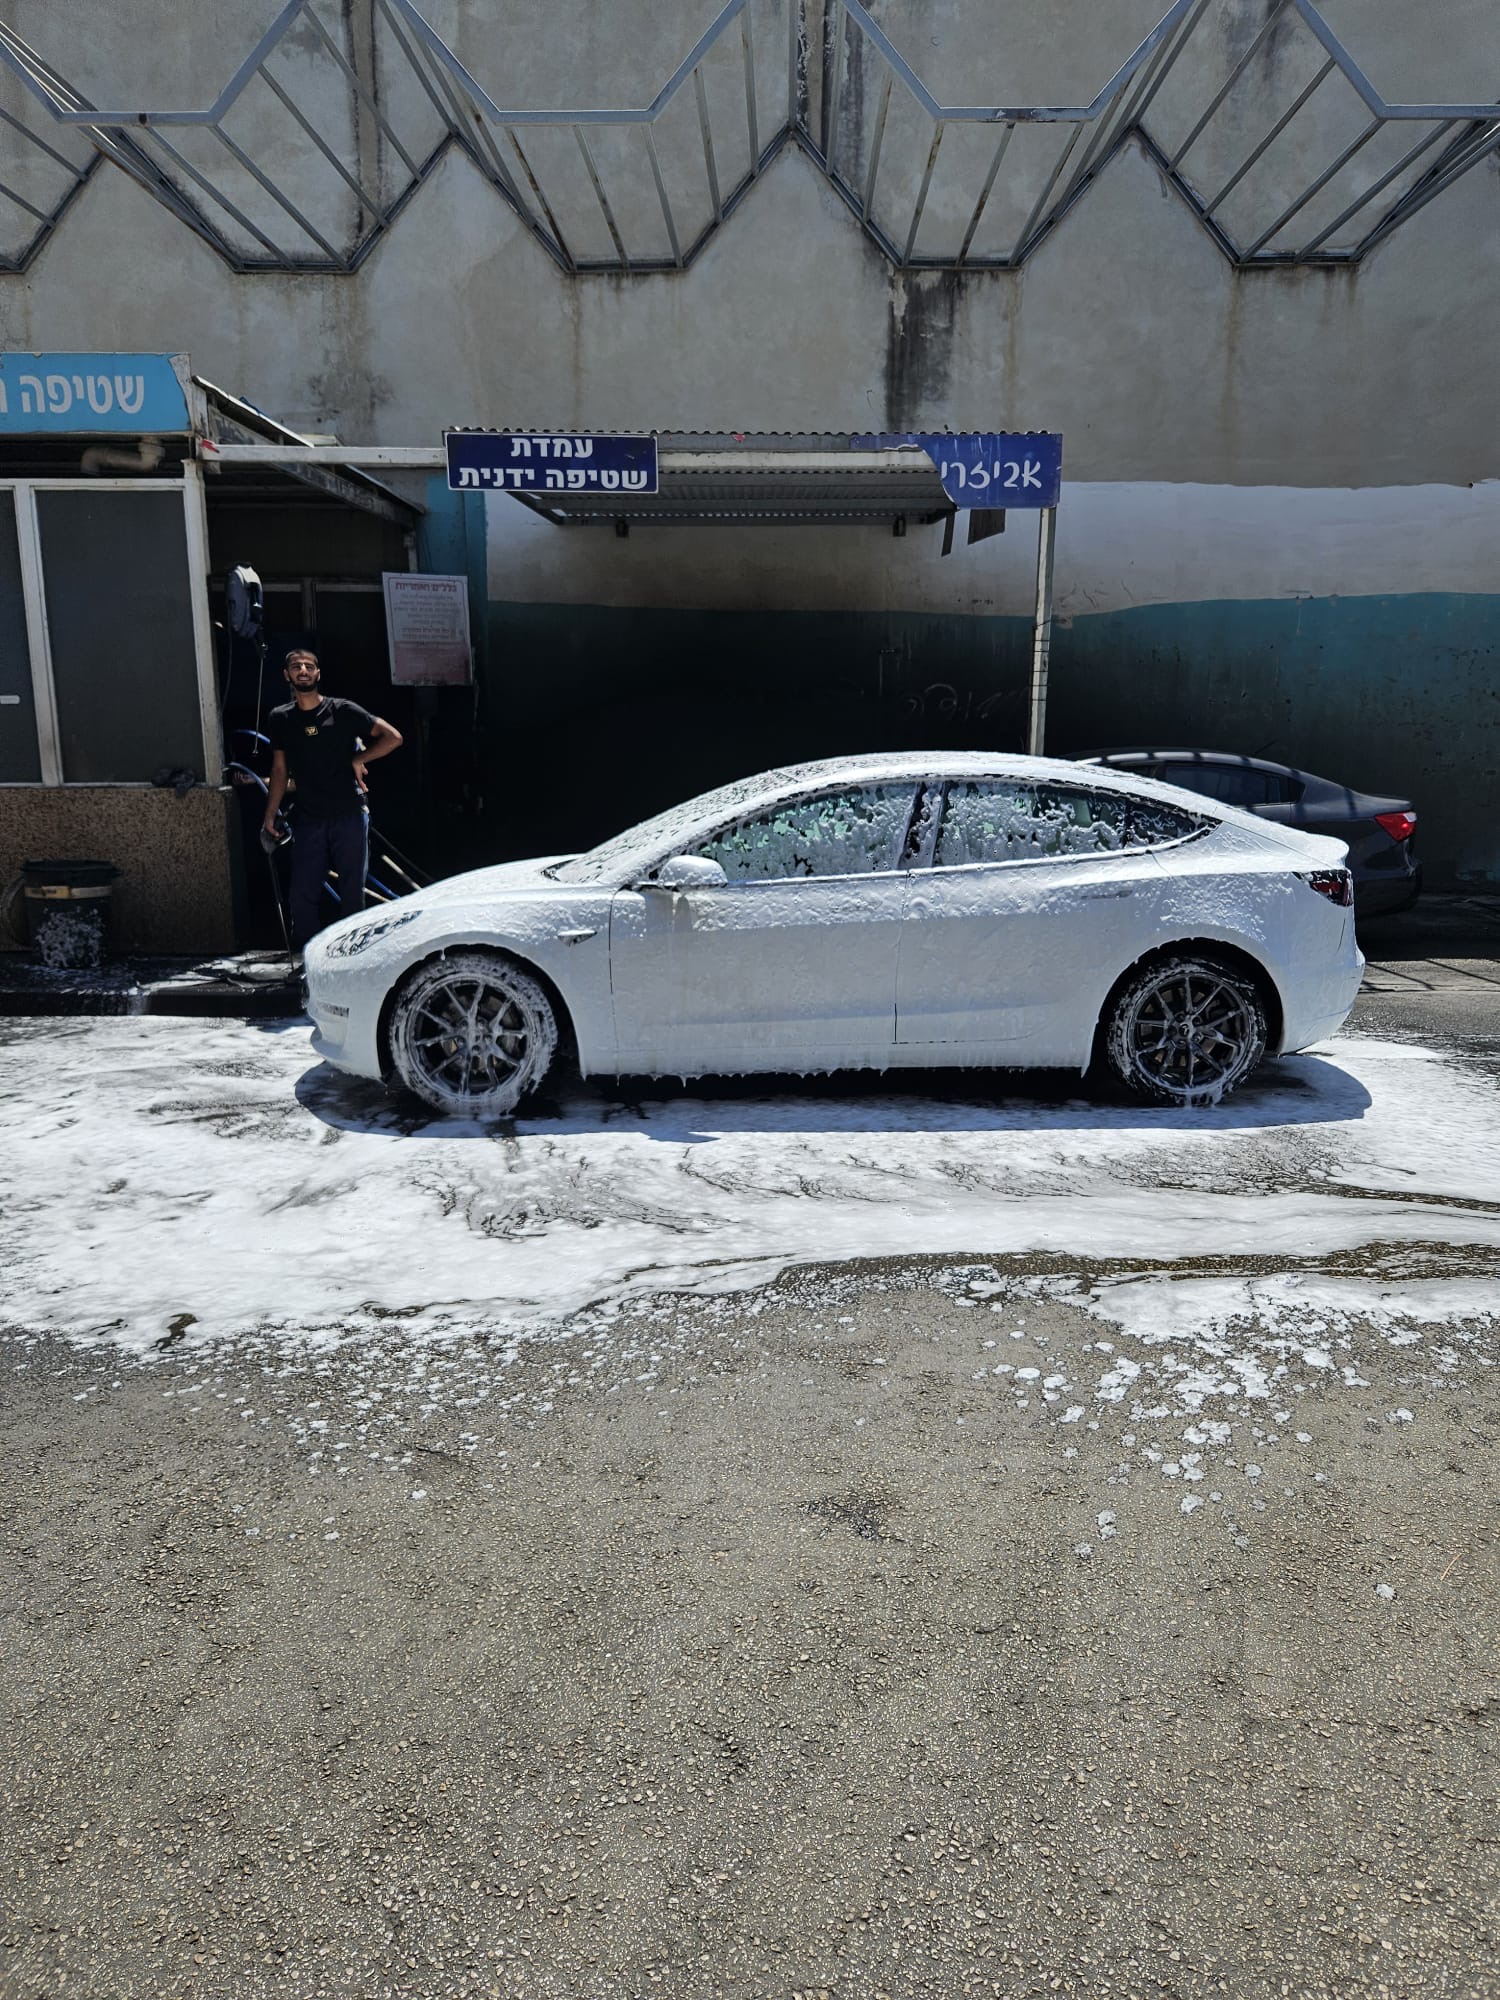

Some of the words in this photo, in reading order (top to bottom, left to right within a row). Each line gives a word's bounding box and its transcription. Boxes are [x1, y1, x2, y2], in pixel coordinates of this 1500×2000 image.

[19, 374, 145, 415] שטיפה
[511, 437, 593, 458] עמדת
[459, 467, 535, 488] ידנית
[545, 468, 648, 490] שטיפה
[941, 460, 1042, 489] אביזרי
